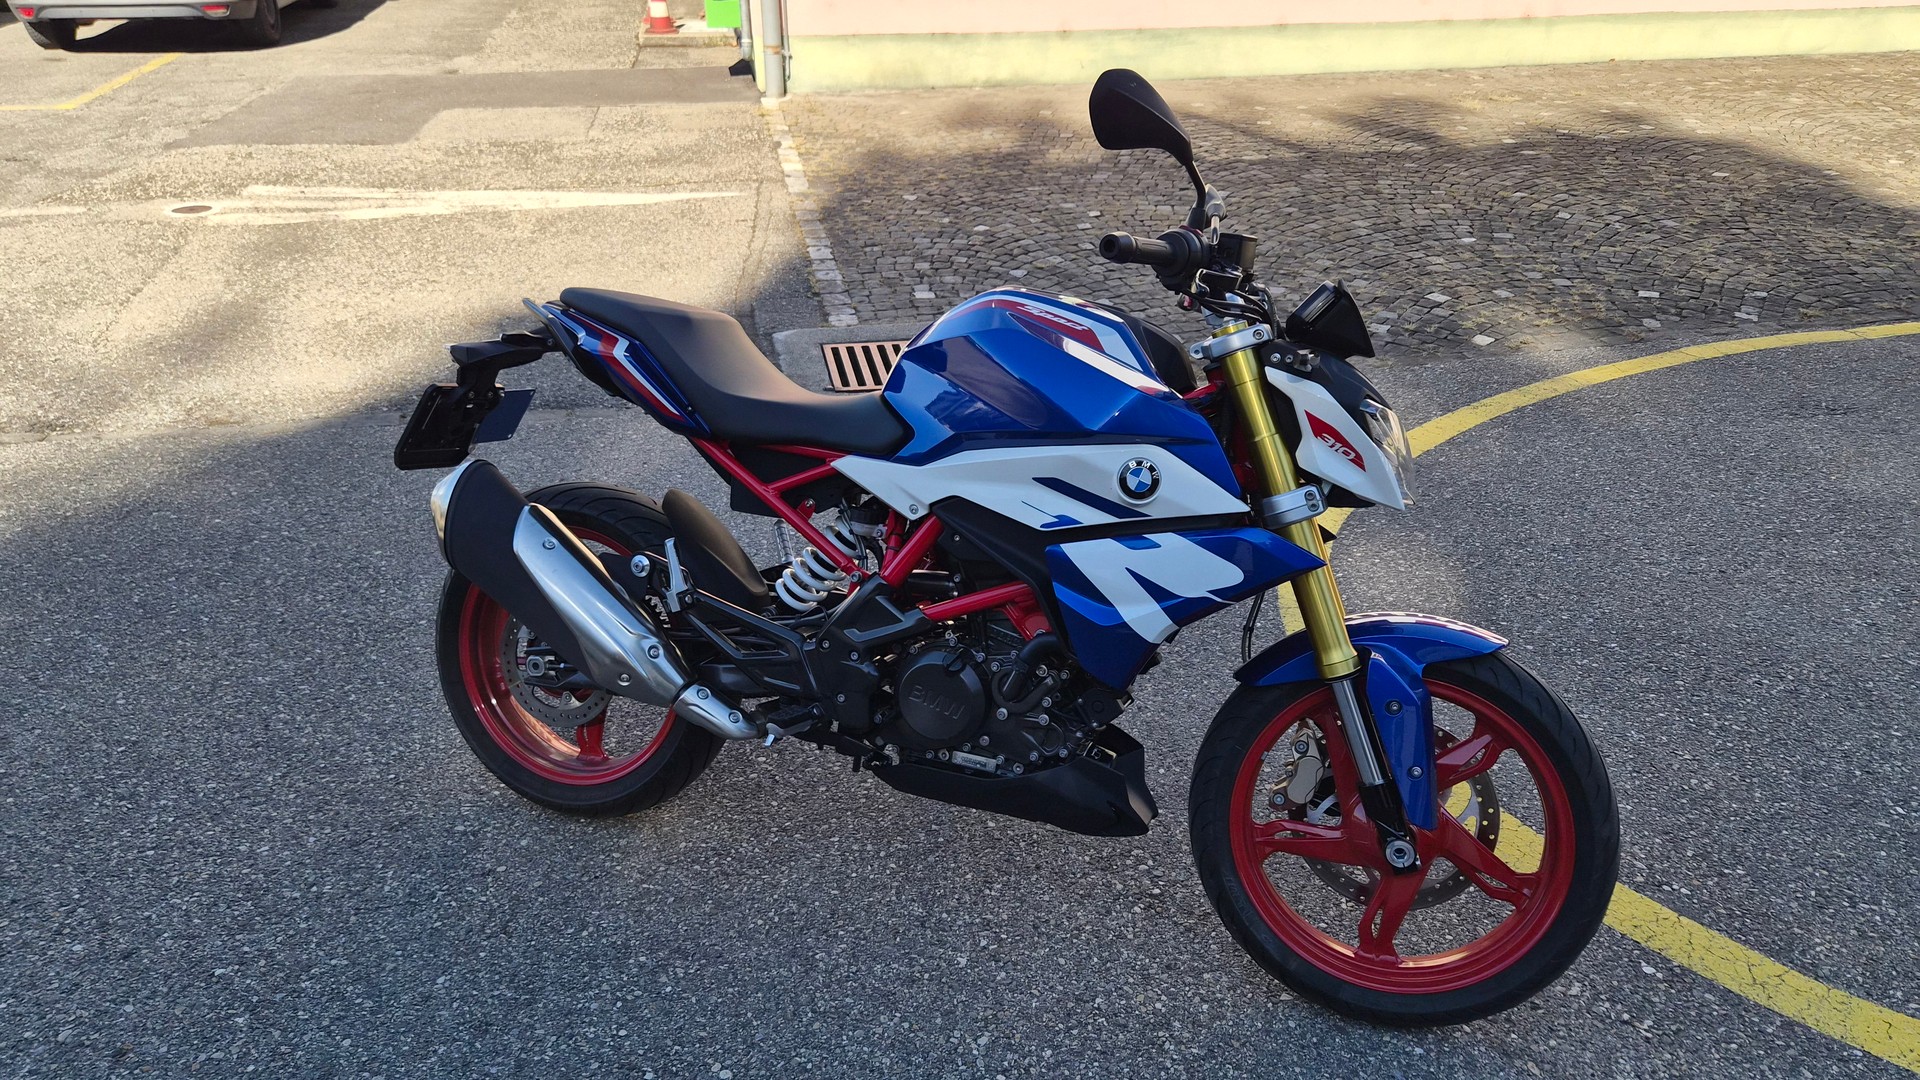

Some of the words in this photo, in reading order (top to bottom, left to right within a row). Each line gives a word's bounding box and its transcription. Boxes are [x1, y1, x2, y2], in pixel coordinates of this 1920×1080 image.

[1317, 433, 1356, 460] 310
[1128, 459, 1160, 479] BMW
[908, 685, 966, 719] BMW
